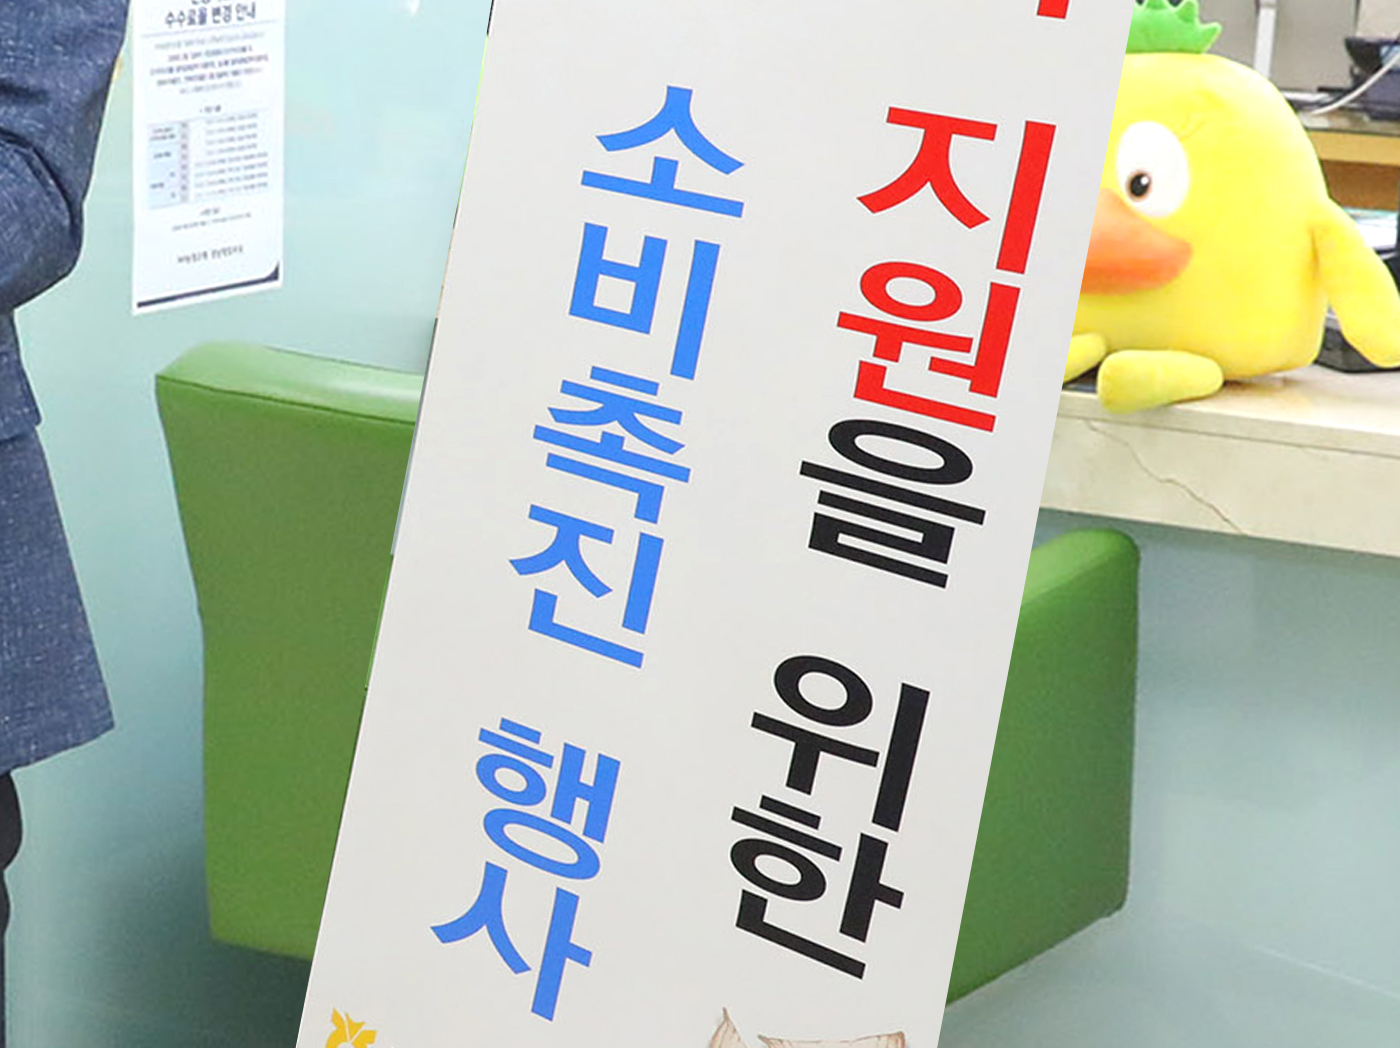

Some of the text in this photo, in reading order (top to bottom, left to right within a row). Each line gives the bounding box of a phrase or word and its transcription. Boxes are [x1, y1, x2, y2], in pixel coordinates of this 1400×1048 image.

[211, 3, 232, 24] 변경
[235, 2, 256, 21] 안내
[501, 86, 744, 667] 소비촉진
[800, 107, 1056, 588] 지원을
[432, 719, 620, 1020] 행사
[731, 656, 929, 979] 위한
